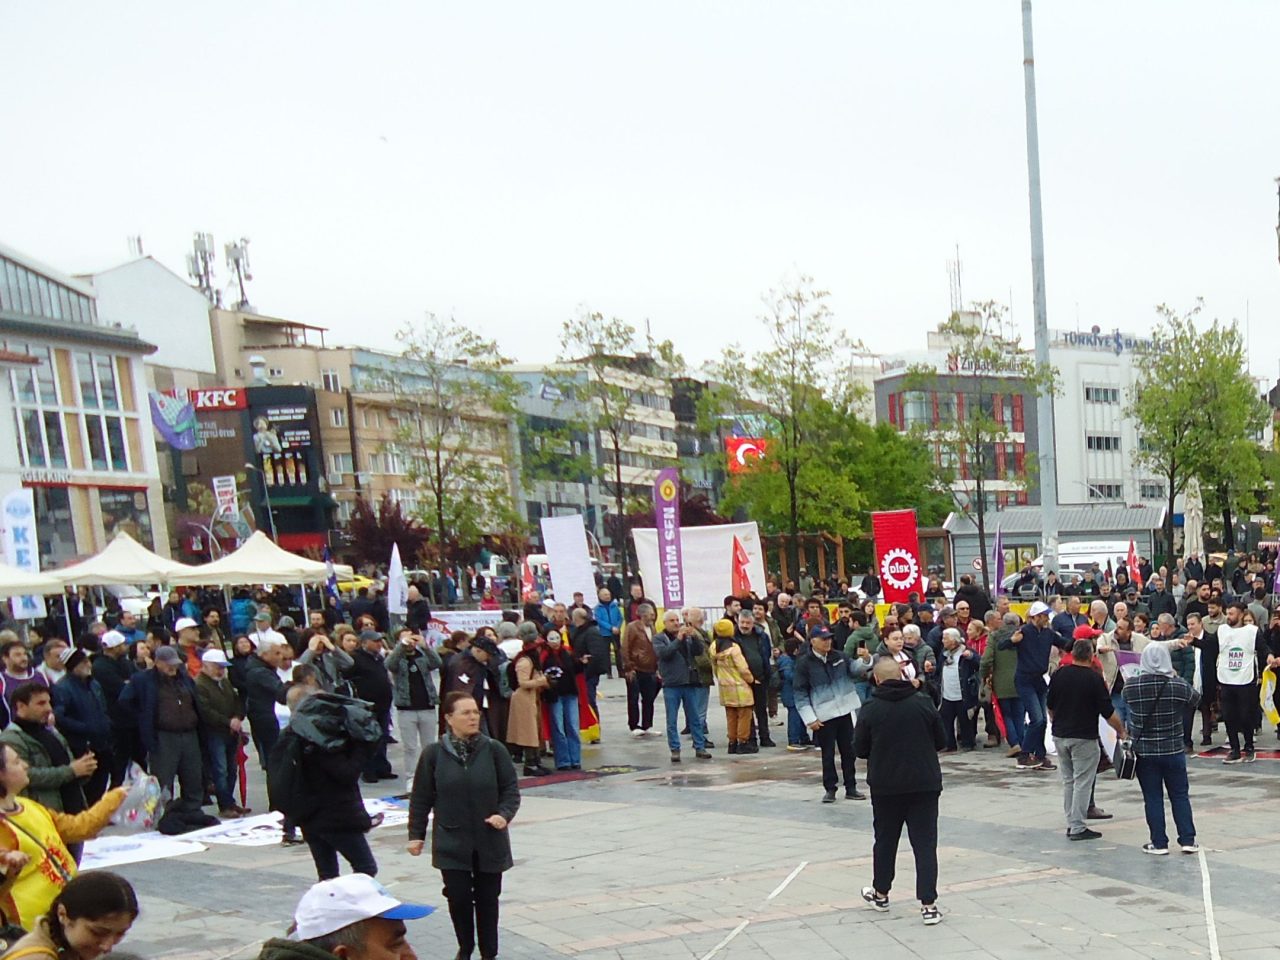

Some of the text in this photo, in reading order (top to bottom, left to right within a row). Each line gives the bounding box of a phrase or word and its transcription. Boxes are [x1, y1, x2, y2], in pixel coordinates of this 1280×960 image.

[1063, 331, 1111, 348] TÜRKİYE
[197, 389, 237, 408] KFC
[663, 507, 676, 540] SEN
[889, 561, 910, 574] DİSK
